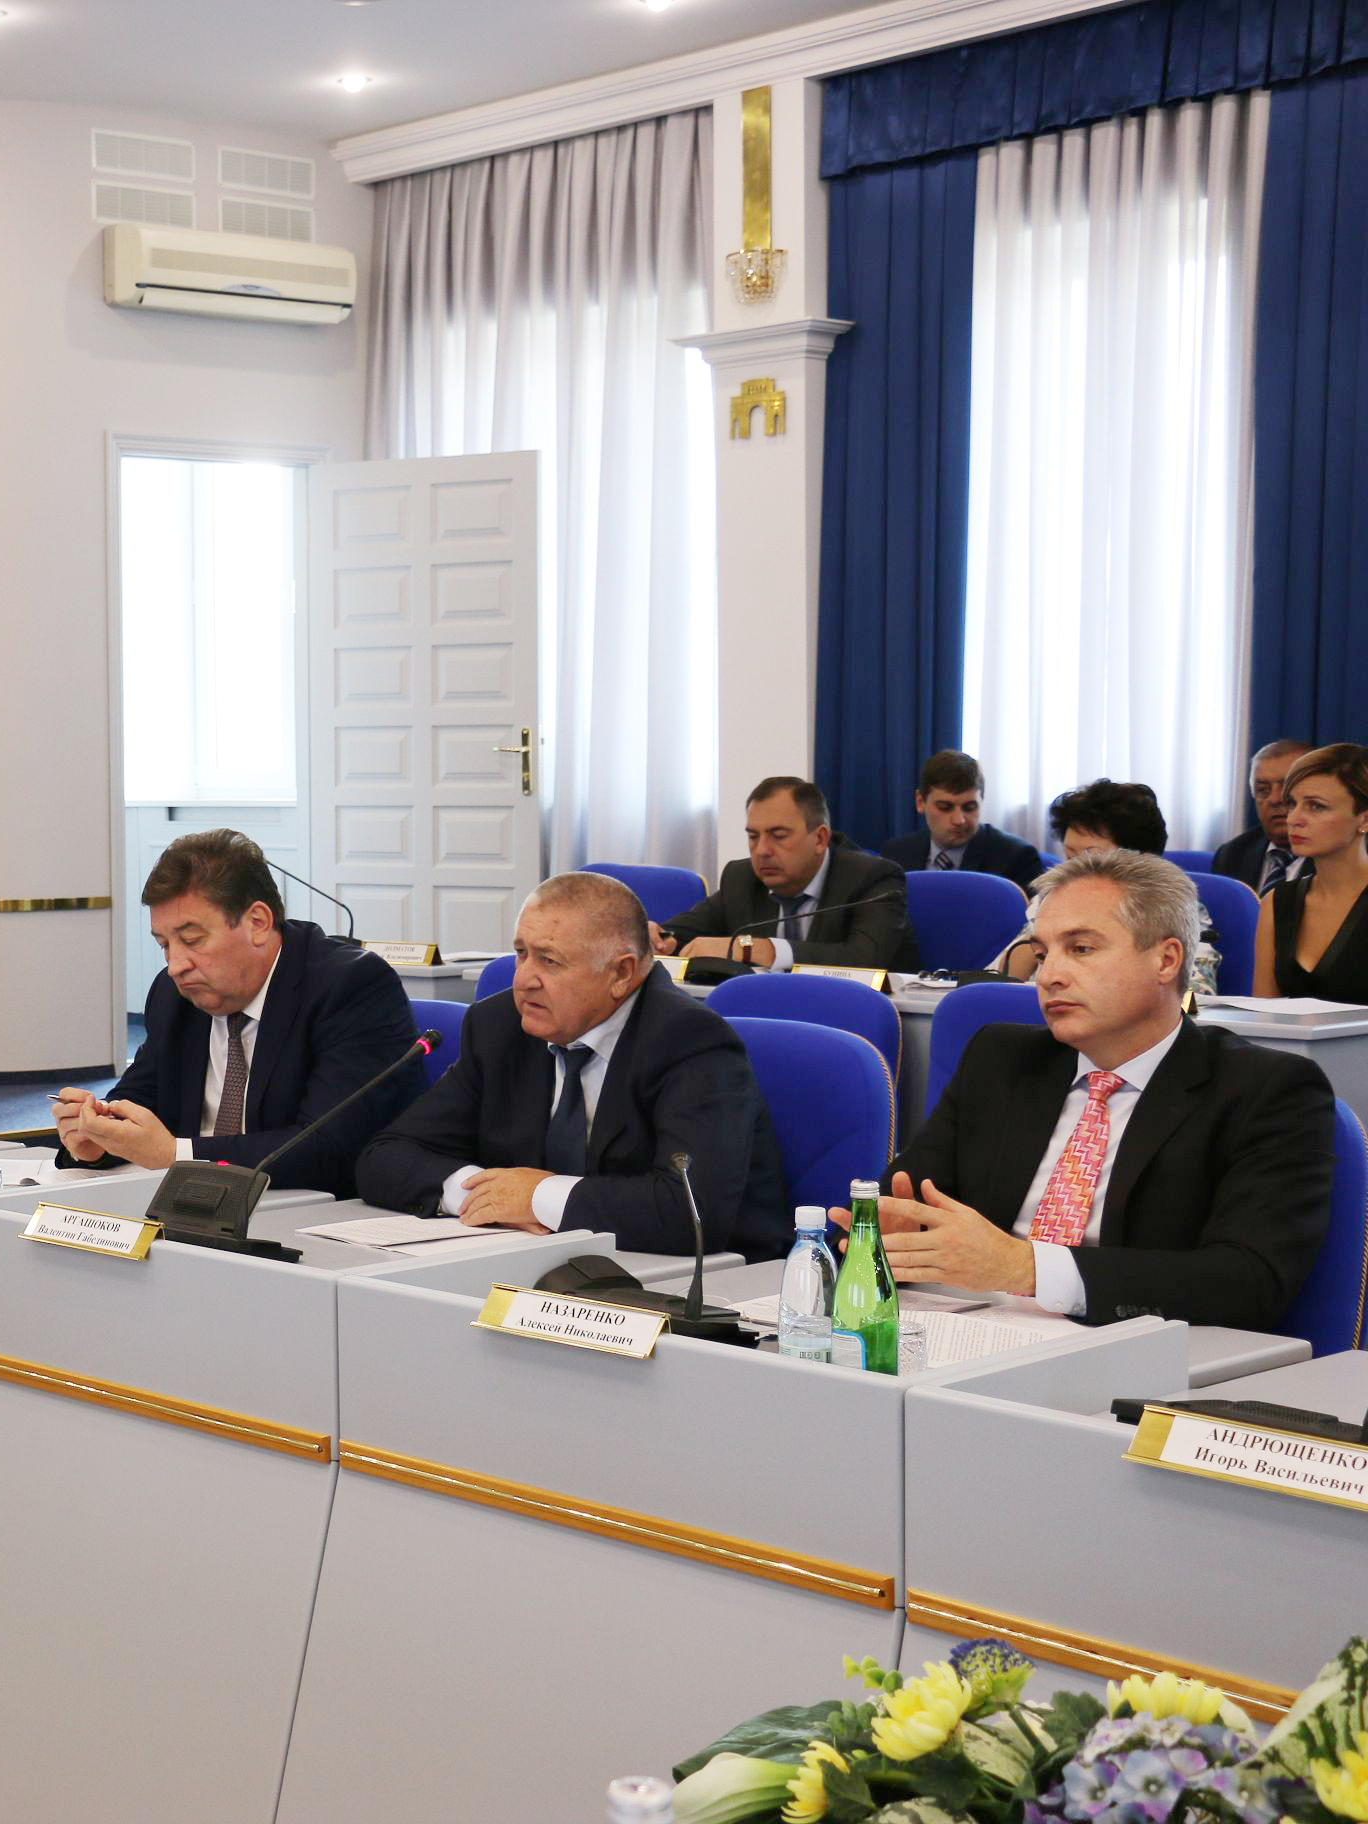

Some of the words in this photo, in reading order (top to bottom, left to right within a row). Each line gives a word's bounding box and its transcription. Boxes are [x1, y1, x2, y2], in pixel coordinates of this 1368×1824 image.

[37, 1224, 76, 1240] Валентин
[60, 1214, 121, 1233] АРГАШОКОВ
[540, 1301, 626, 1326] НАЗАРЕНКО
[516, 1317, 562, 1333] Алексей
[563, 1323, 634, 1346] Николаевич
[1205, 1427, 1368, 1472] АНДРЮЩЕНКО
[1194, 1446, 1248, 1471] Игорь
[1253, 1458, 1365, 1495] Васильевич
